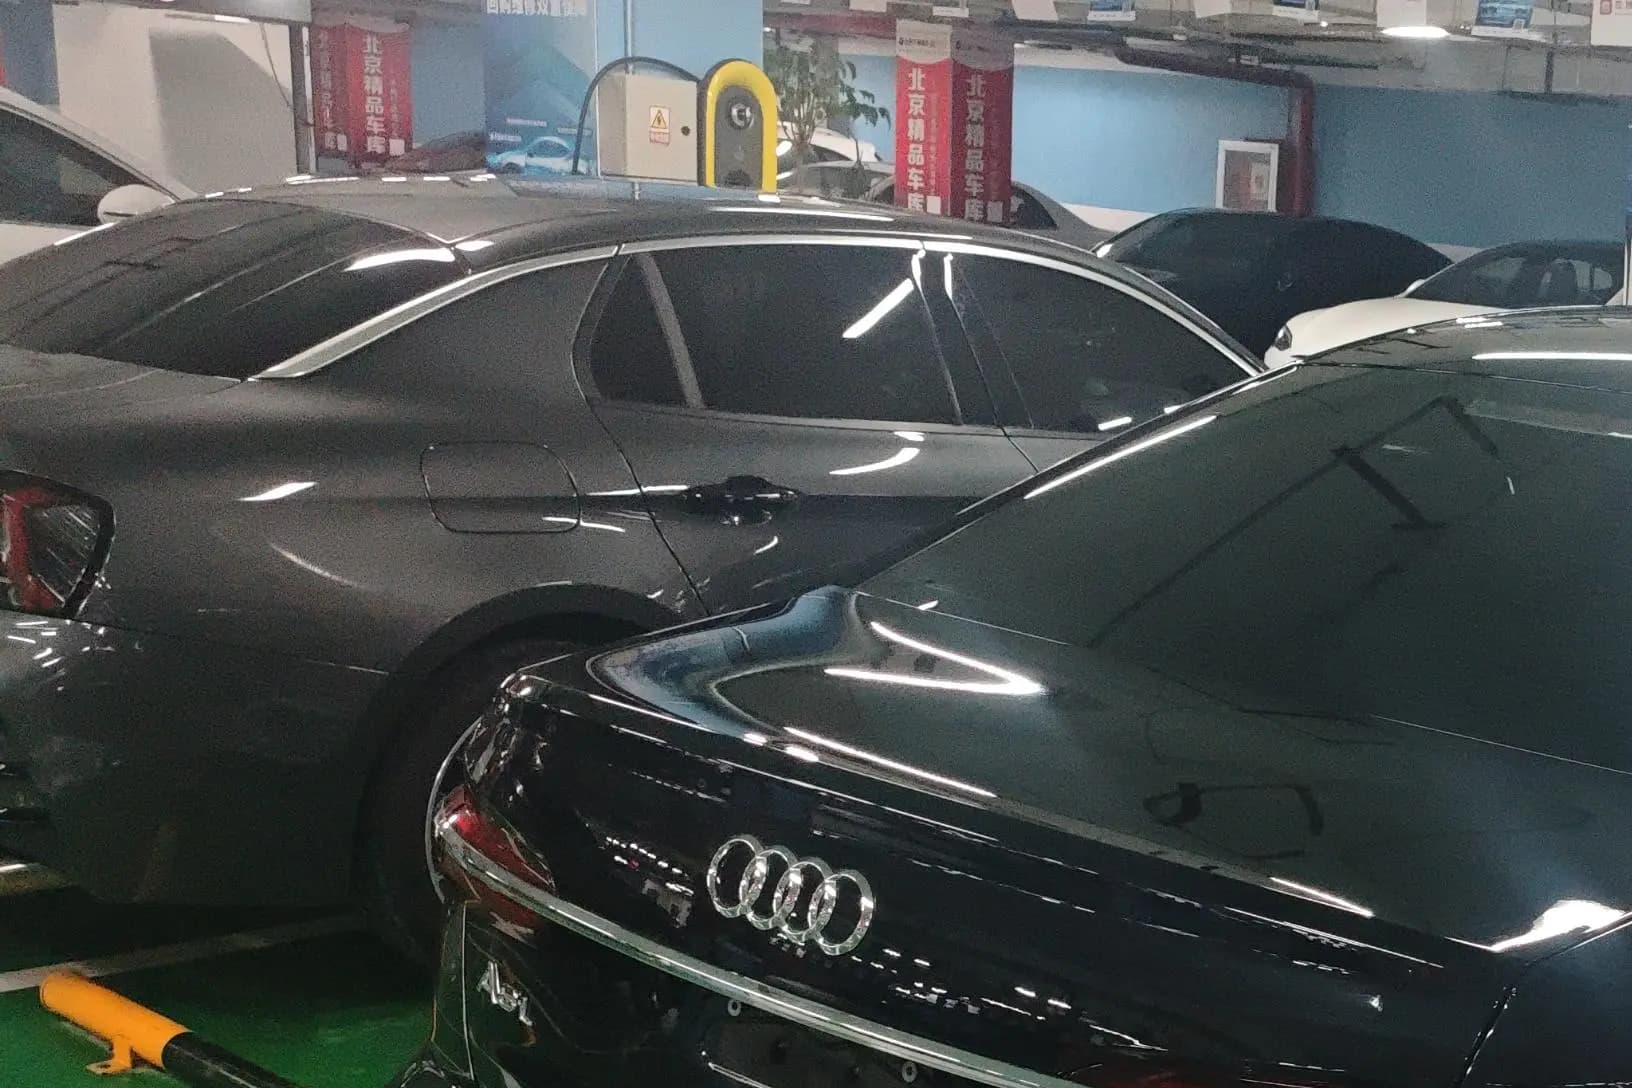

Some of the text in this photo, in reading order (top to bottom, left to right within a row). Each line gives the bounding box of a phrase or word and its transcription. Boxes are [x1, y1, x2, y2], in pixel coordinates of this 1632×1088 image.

[362, 35, 386, 153] 北京精品车库
[907, 67, 926, 212] 北京精品车库
[964, 74, 986, 222] 北京精品车库
